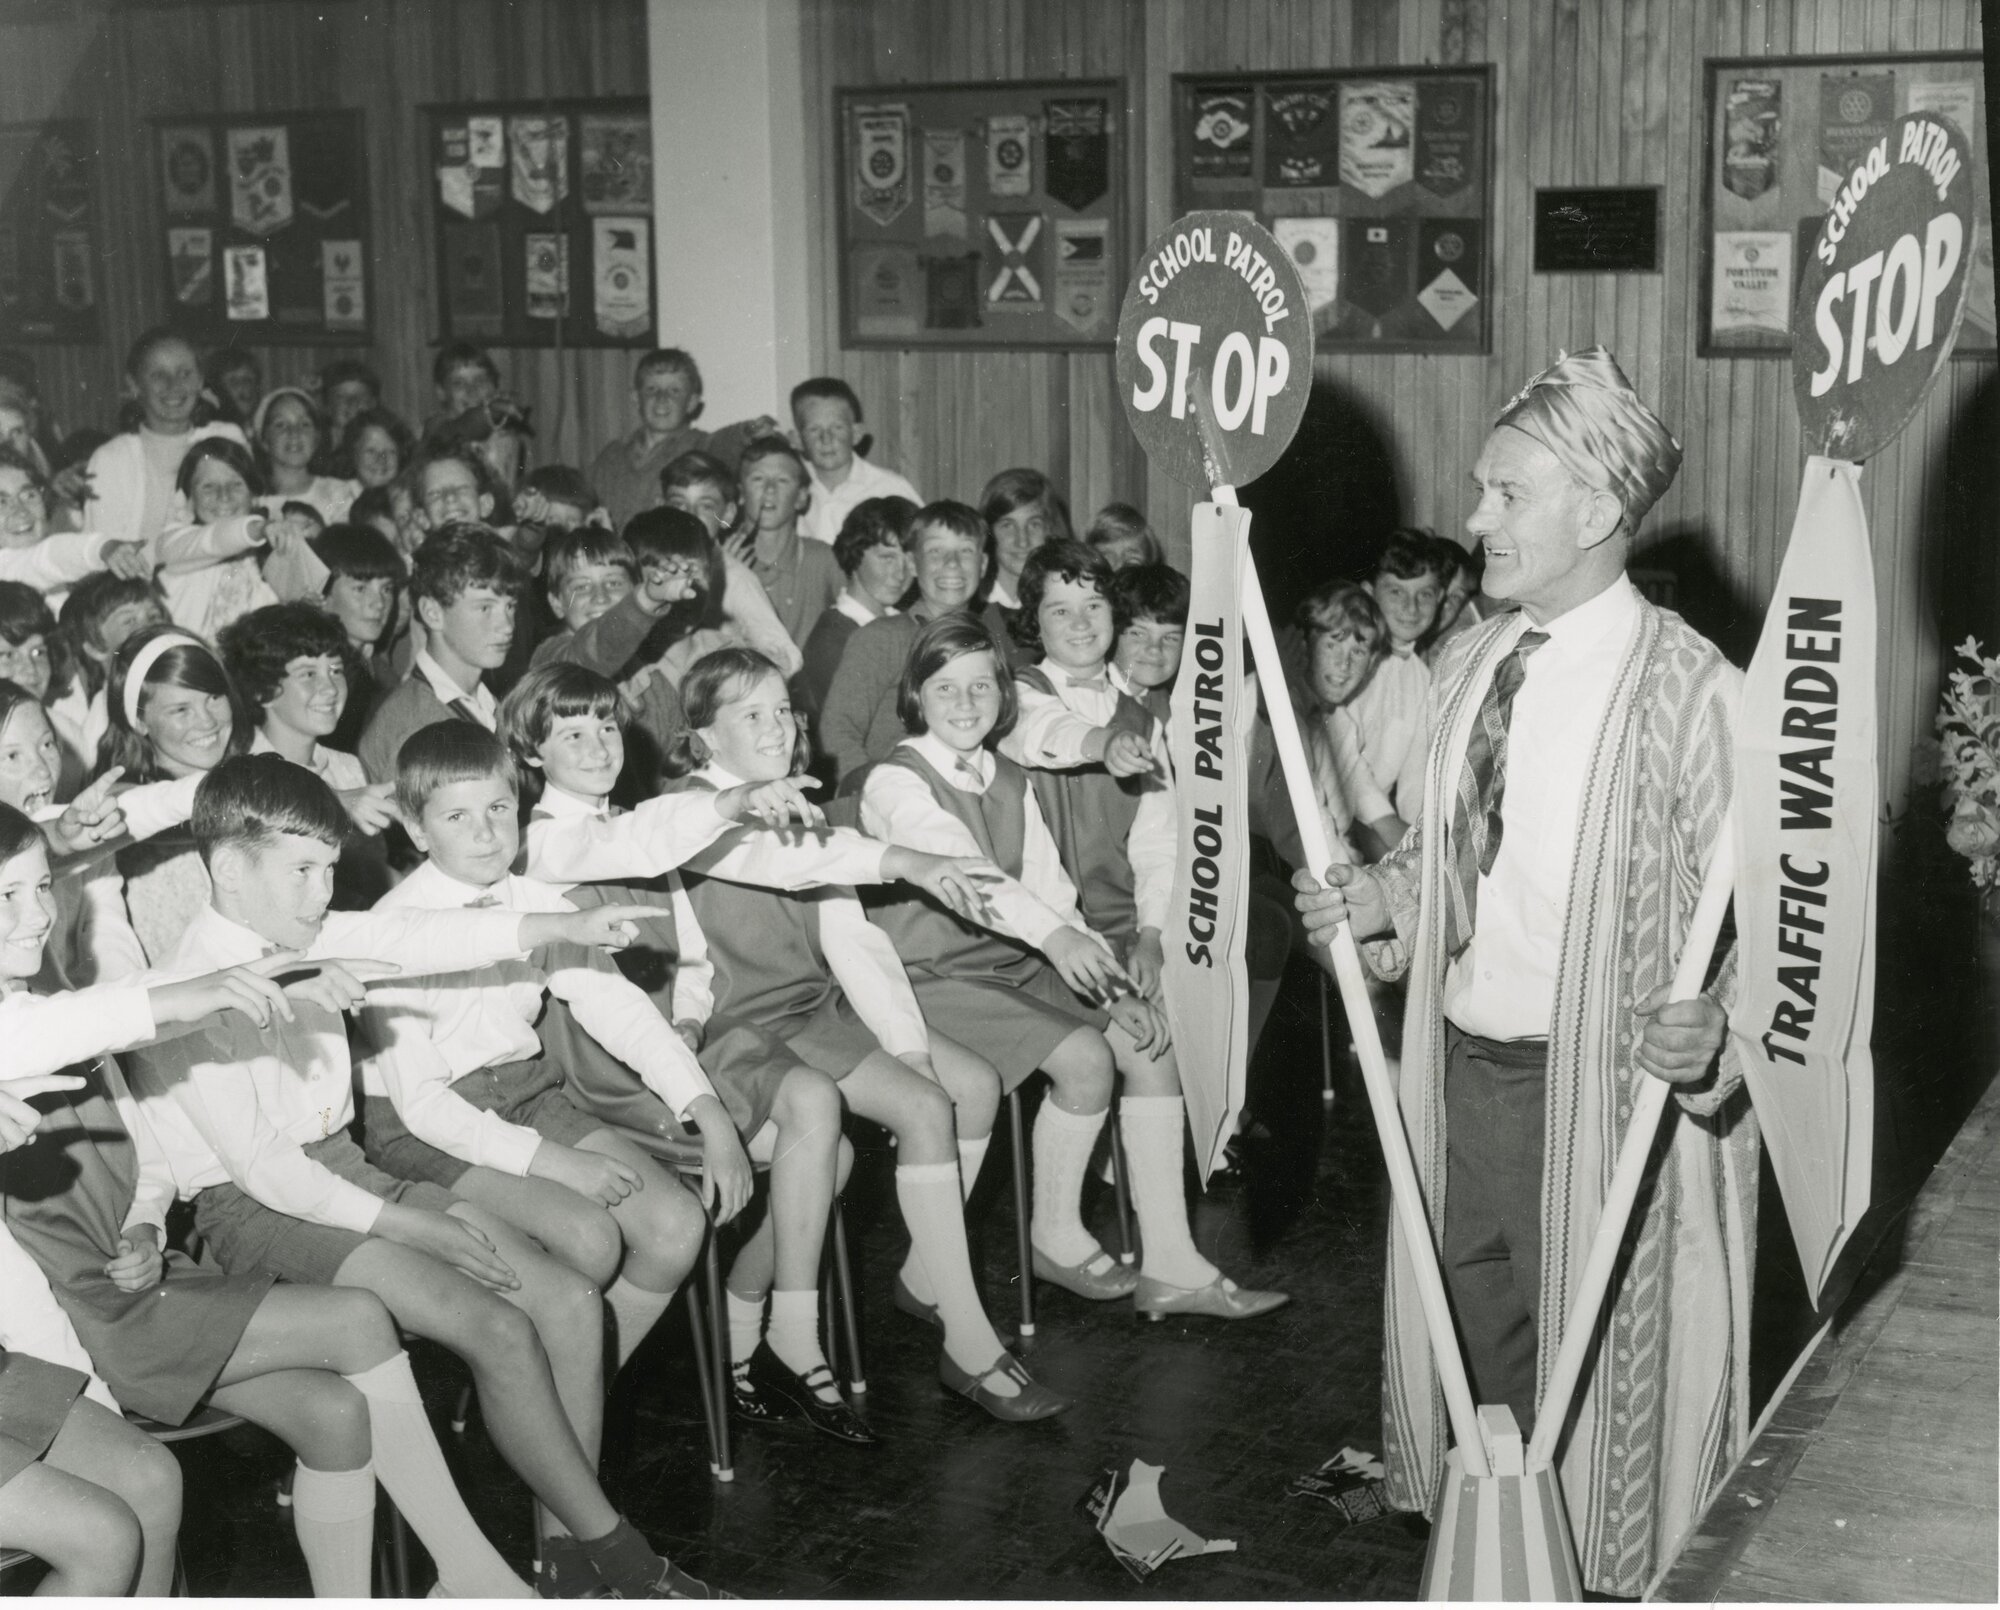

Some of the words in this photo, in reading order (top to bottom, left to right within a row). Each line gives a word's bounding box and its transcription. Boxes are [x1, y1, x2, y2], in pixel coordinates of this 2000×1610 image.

[1818, 137, 1890, 266] SCHOOL
[1899, 119, 1962, 201] PATROL
[1139, 228, 1216, 304] SCHOOL
[1224, 232, 1289, 335] PATROL
[1811, 212, 1963, 397] STOP
[1132, 316, 1290, 435] STOP
[1193, 617, 1225, 780] PATROL
[1779, 597, 1842, 830] WARDEN
[1185, 804, 1223, 968] SCHOOL
[1761, 854, 1829, 1067] TRAFFIC
